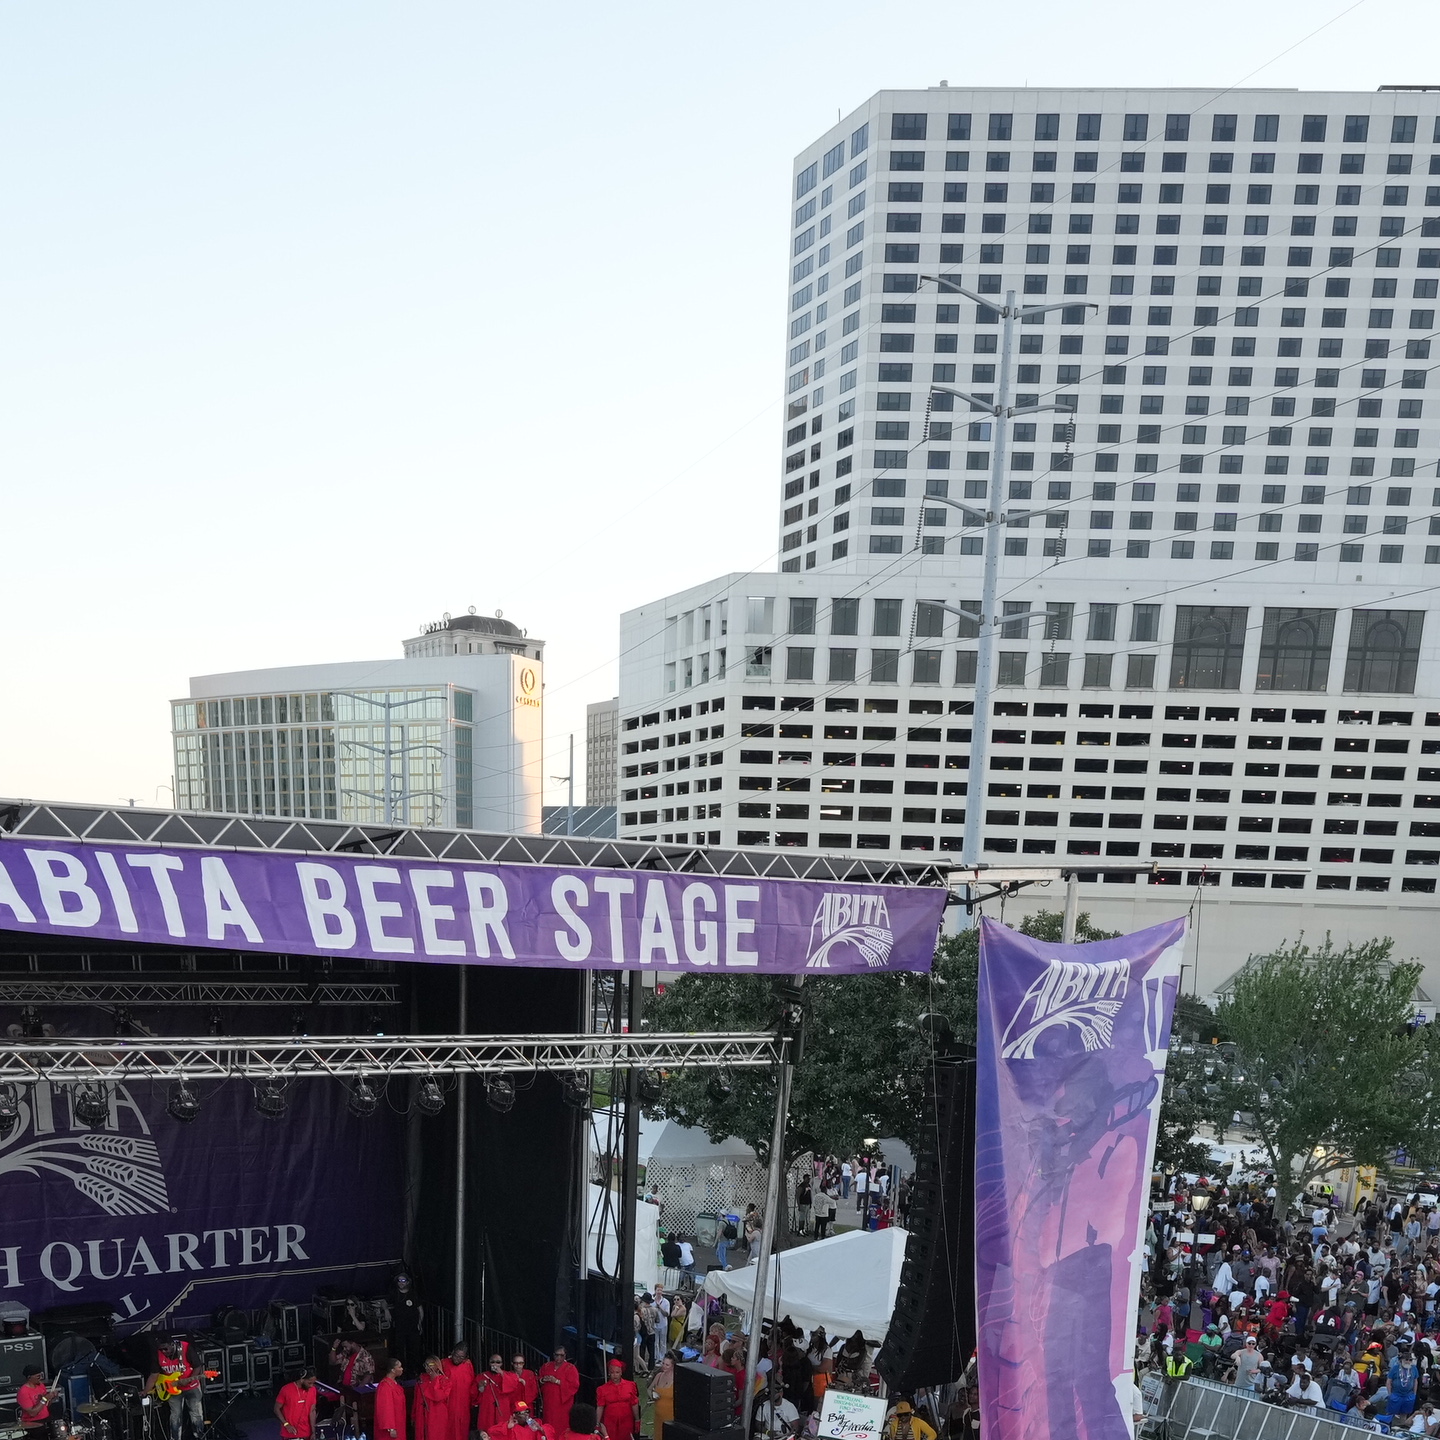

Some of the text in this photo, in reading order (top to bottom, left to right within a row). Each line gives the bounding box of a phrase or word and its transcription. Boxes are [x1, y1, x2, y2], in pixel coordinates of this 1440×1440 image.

[296, 861, 516, 960] BEER
[551, 873, 762, 967] STAGE
[806, 892, 891, 958] ABITA
[1001, 958, 1131, 1048] ABITA
[39, 1223, 310, 1287] QUARTER
[3, 1342, 34, 1354] PSS
[828, 1412, 847, 1427] Big
[831, 1419, 876, 1436] Freedia
